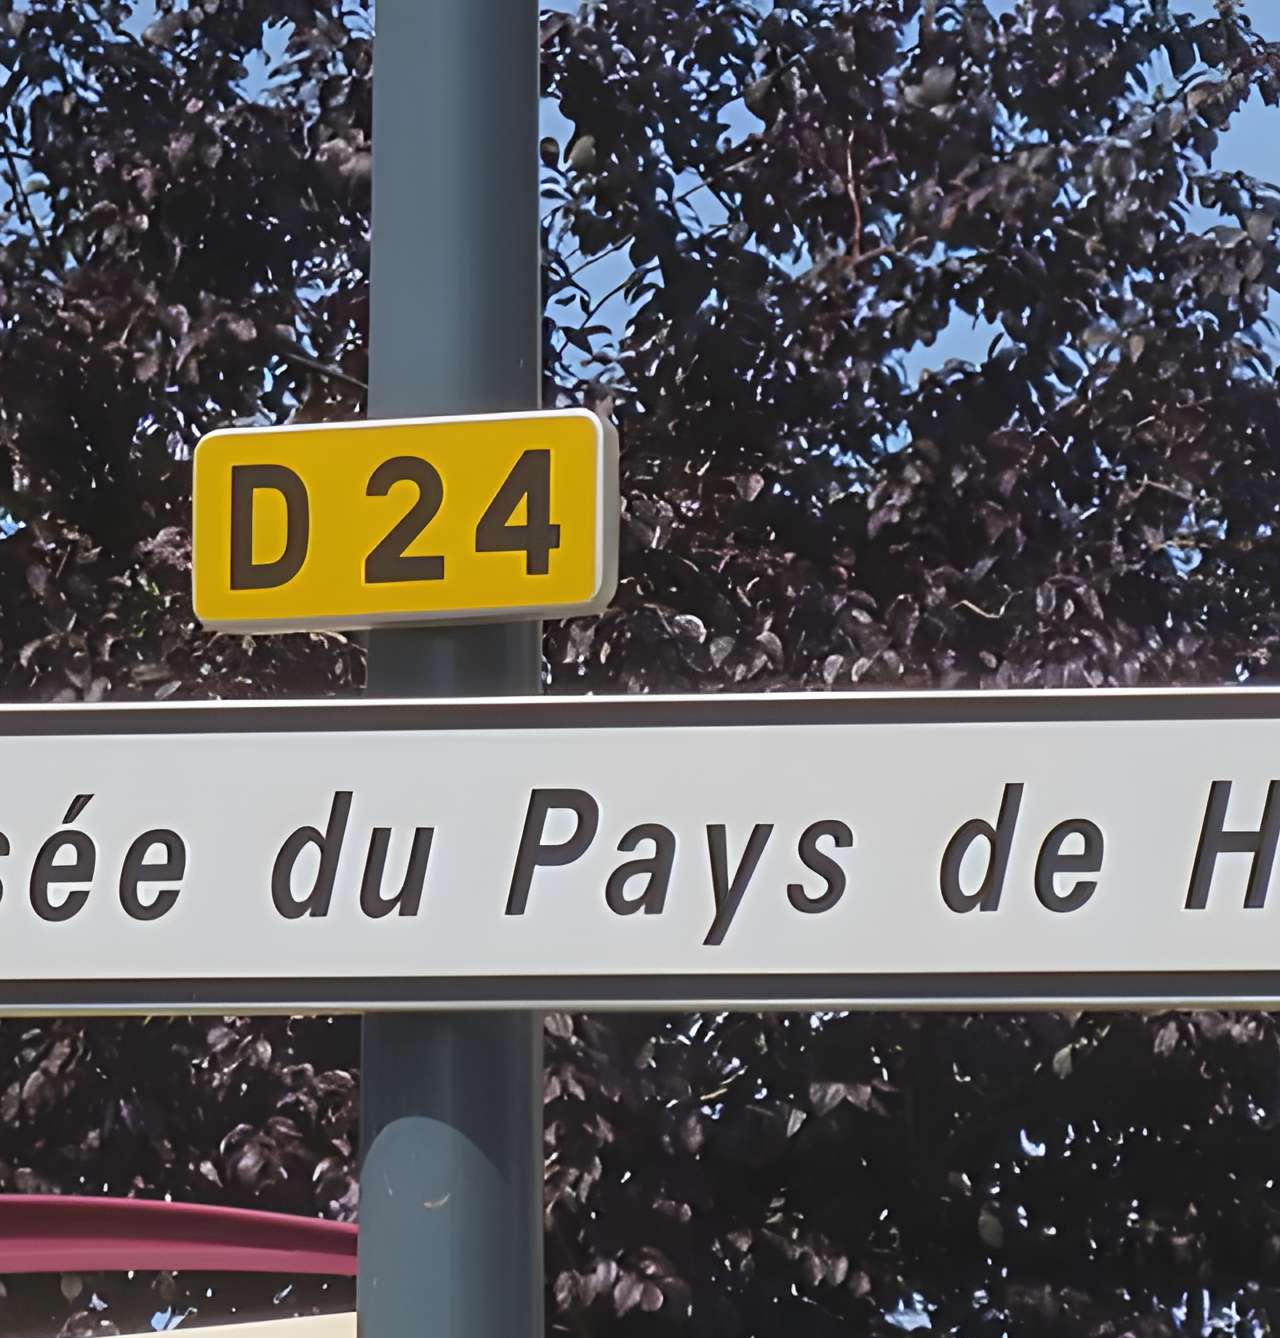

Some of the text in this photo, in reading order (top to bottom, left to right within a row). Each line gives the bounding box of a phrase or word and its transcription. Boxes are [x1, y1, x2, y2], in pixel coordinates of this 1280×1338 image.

[229, 448, 561, 591] D 24
[271, 790, 435, 920] du
[504, 788, 854, 946] Pays
[939, 782, 1104, 914] de
